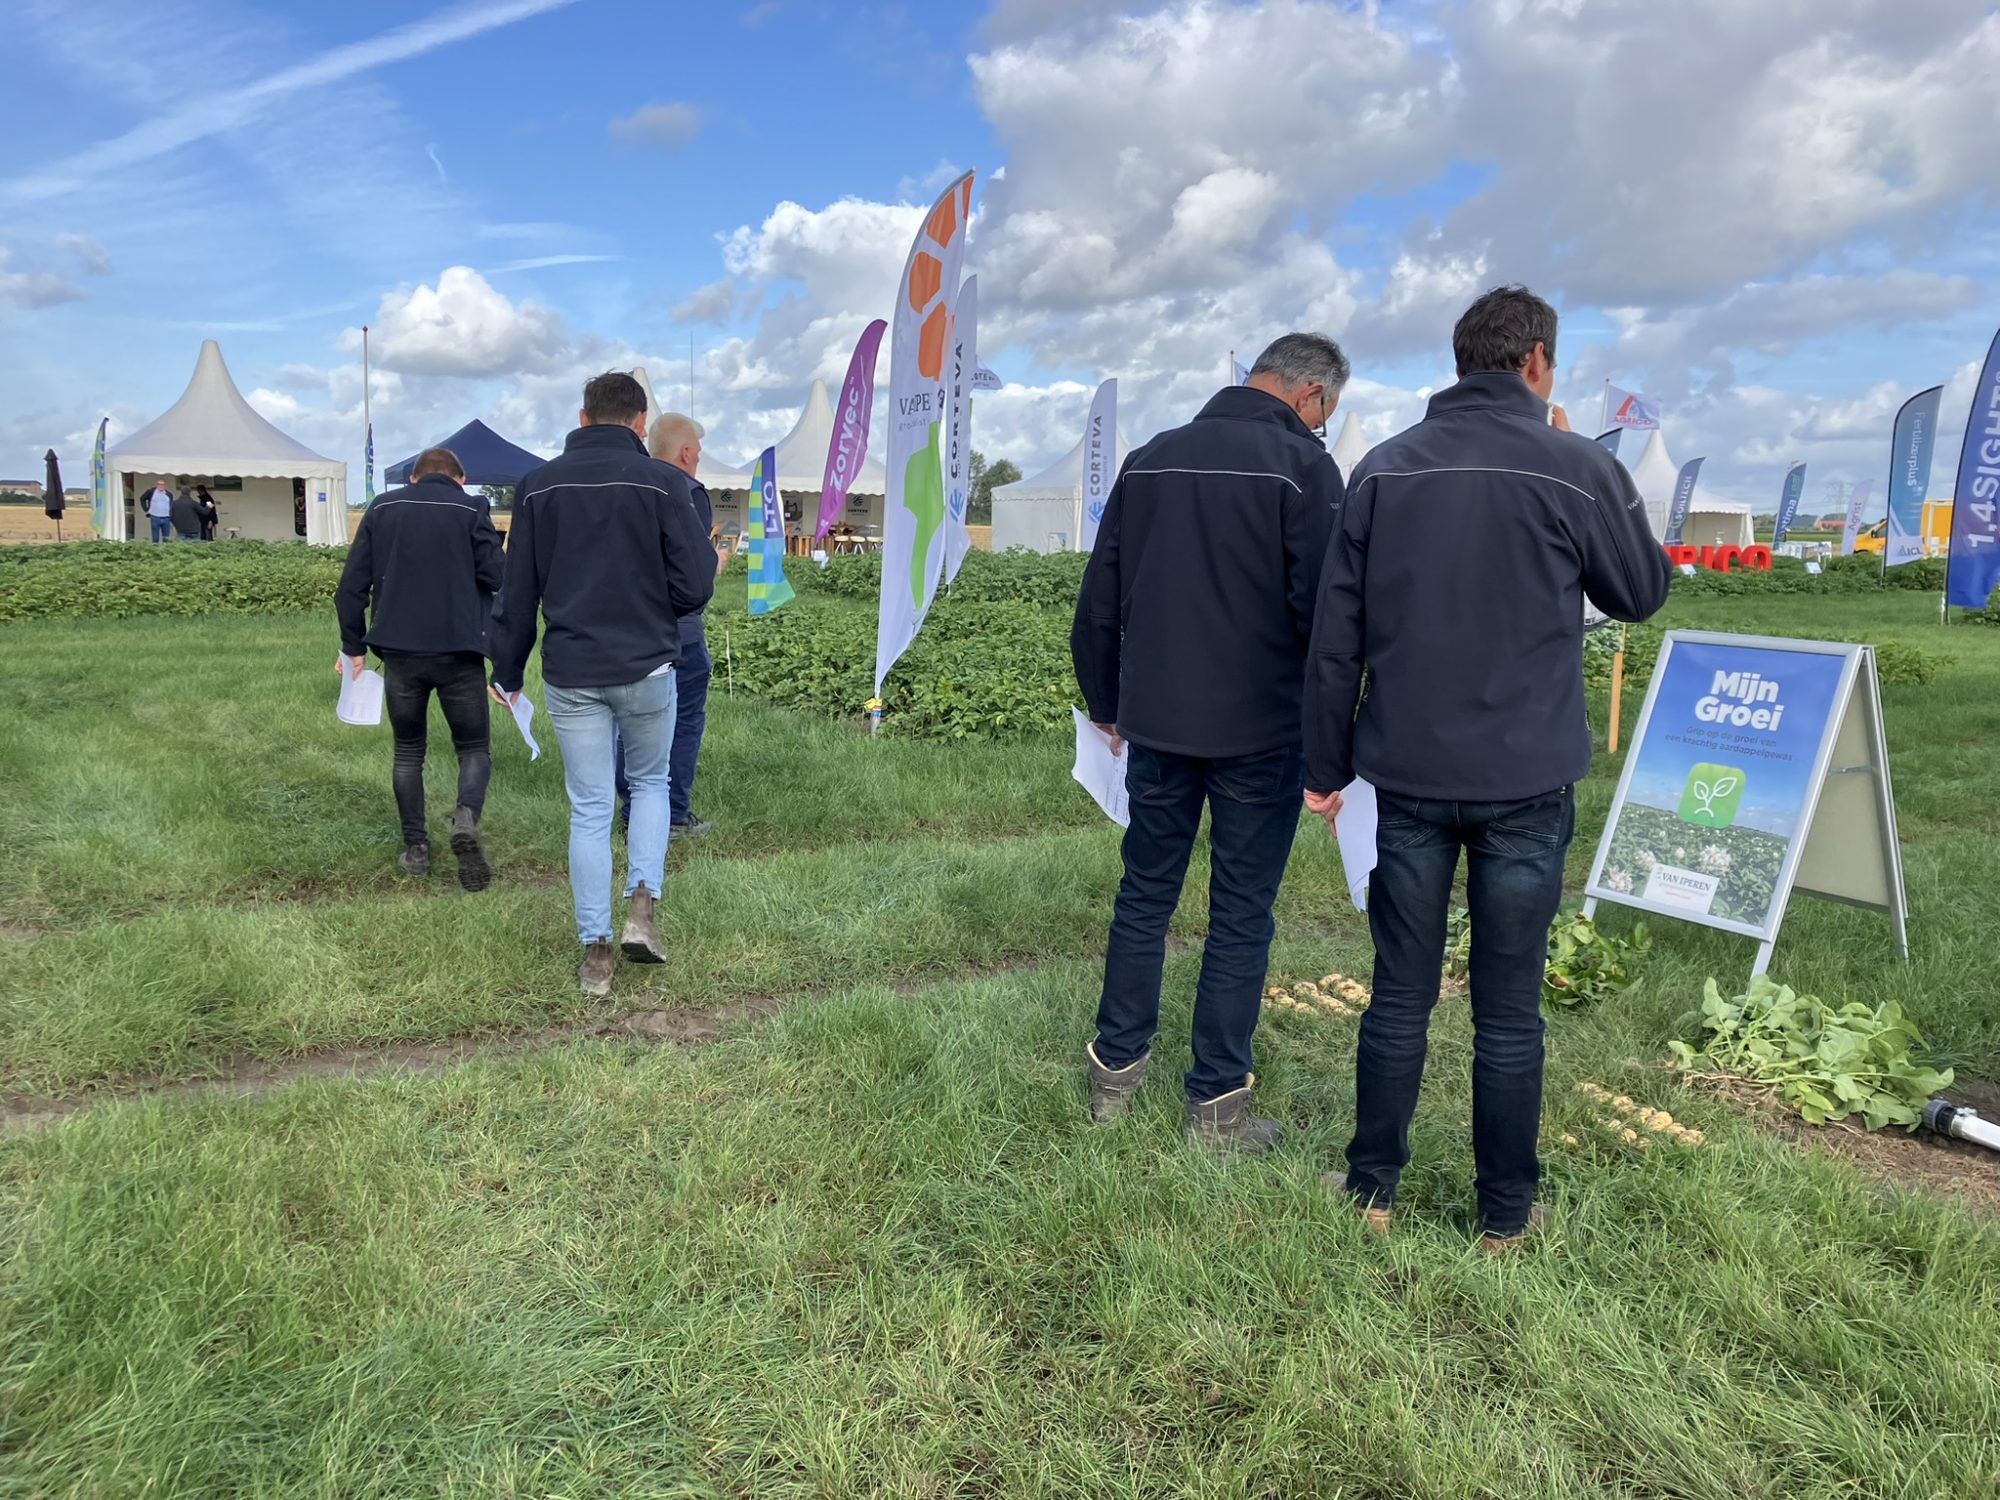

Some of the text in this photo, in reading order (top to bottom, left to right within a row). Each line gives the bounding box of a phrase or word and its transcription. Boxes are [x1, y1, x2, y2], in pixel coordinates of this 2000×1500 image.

[951, 342, 963, 479] CORTEVA
[1090, 415, 1102, 496] CORTEVA
[764, 480, 778, 533] LTO
[1710, 669, 1780, 705] Mijn
[1693, 694, 1785, 732] Groei
[1682, 736, 1718, 750] krachtig
[1719, 742, 1793, 762] aardappelgewas
[1662, 872, 1679, 883] VAN
[1680, 877, 1711, 891] IPEREN
